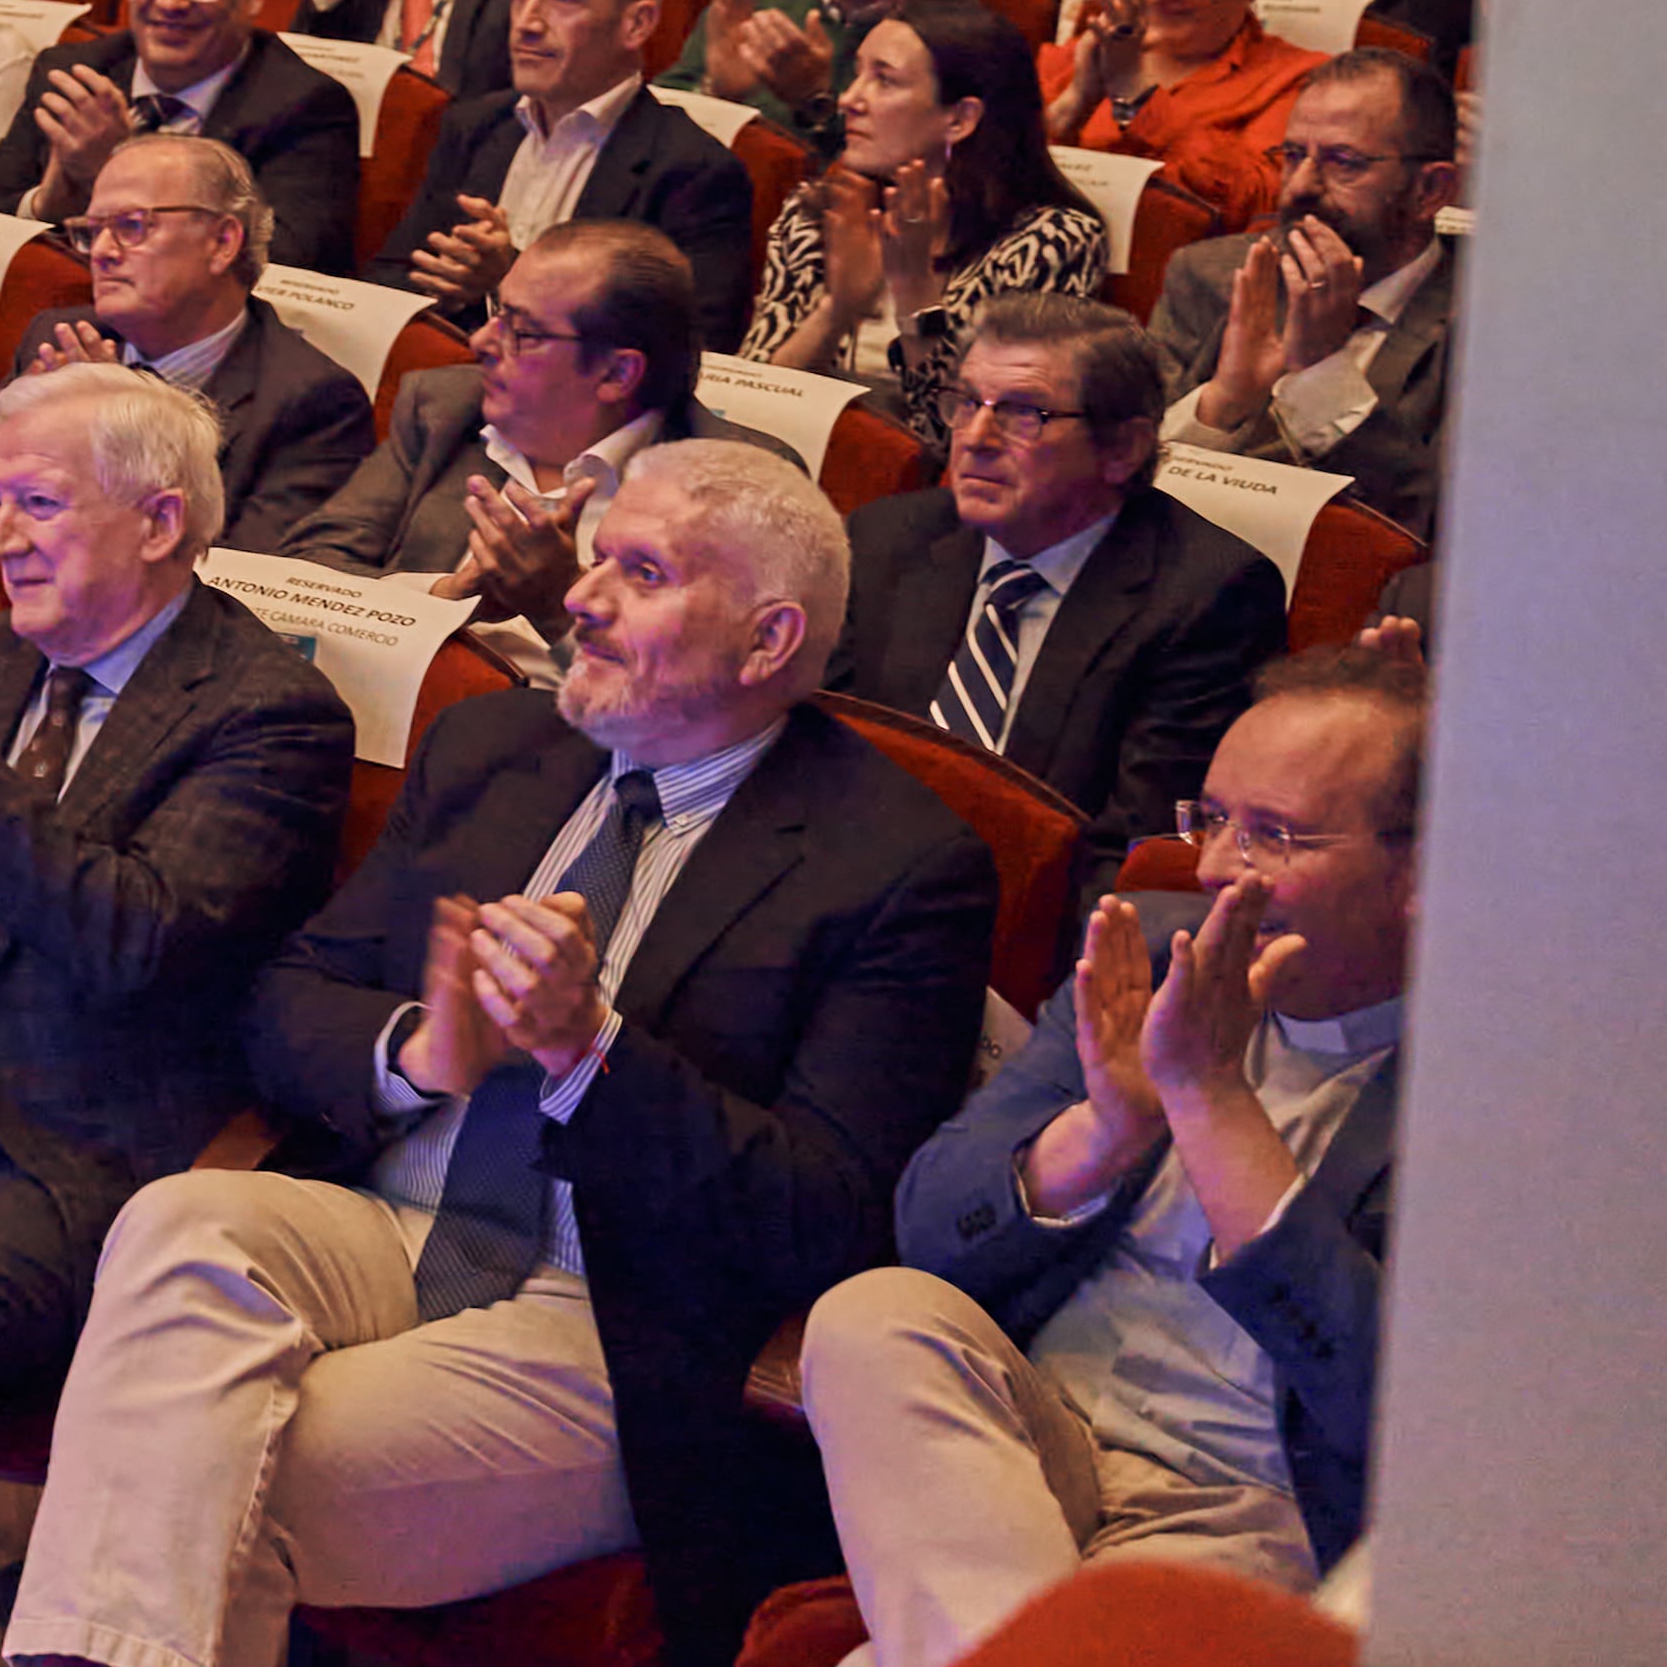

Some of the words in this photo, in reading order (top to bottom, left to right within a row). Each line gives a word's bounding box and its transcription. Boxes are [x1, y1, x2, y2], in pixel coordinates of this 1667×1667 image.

[288, 292, 355, 311] POLANCO
[734, 378, 804, 397] PASCUAL
[1168, 465, 1192, 478] DE
[1195, 471, 1217, 483] LA
[1222, 476, 1278, 495] VIUDA
[286, 577, 363, 599] RESERVADO
[208, 576, 288, 600] ANTONIO
[289, 593, 366, 617] MENDEZ
[366, 608, 417, 627] POZO
[327, 623, 399, 647] COMERCIO
